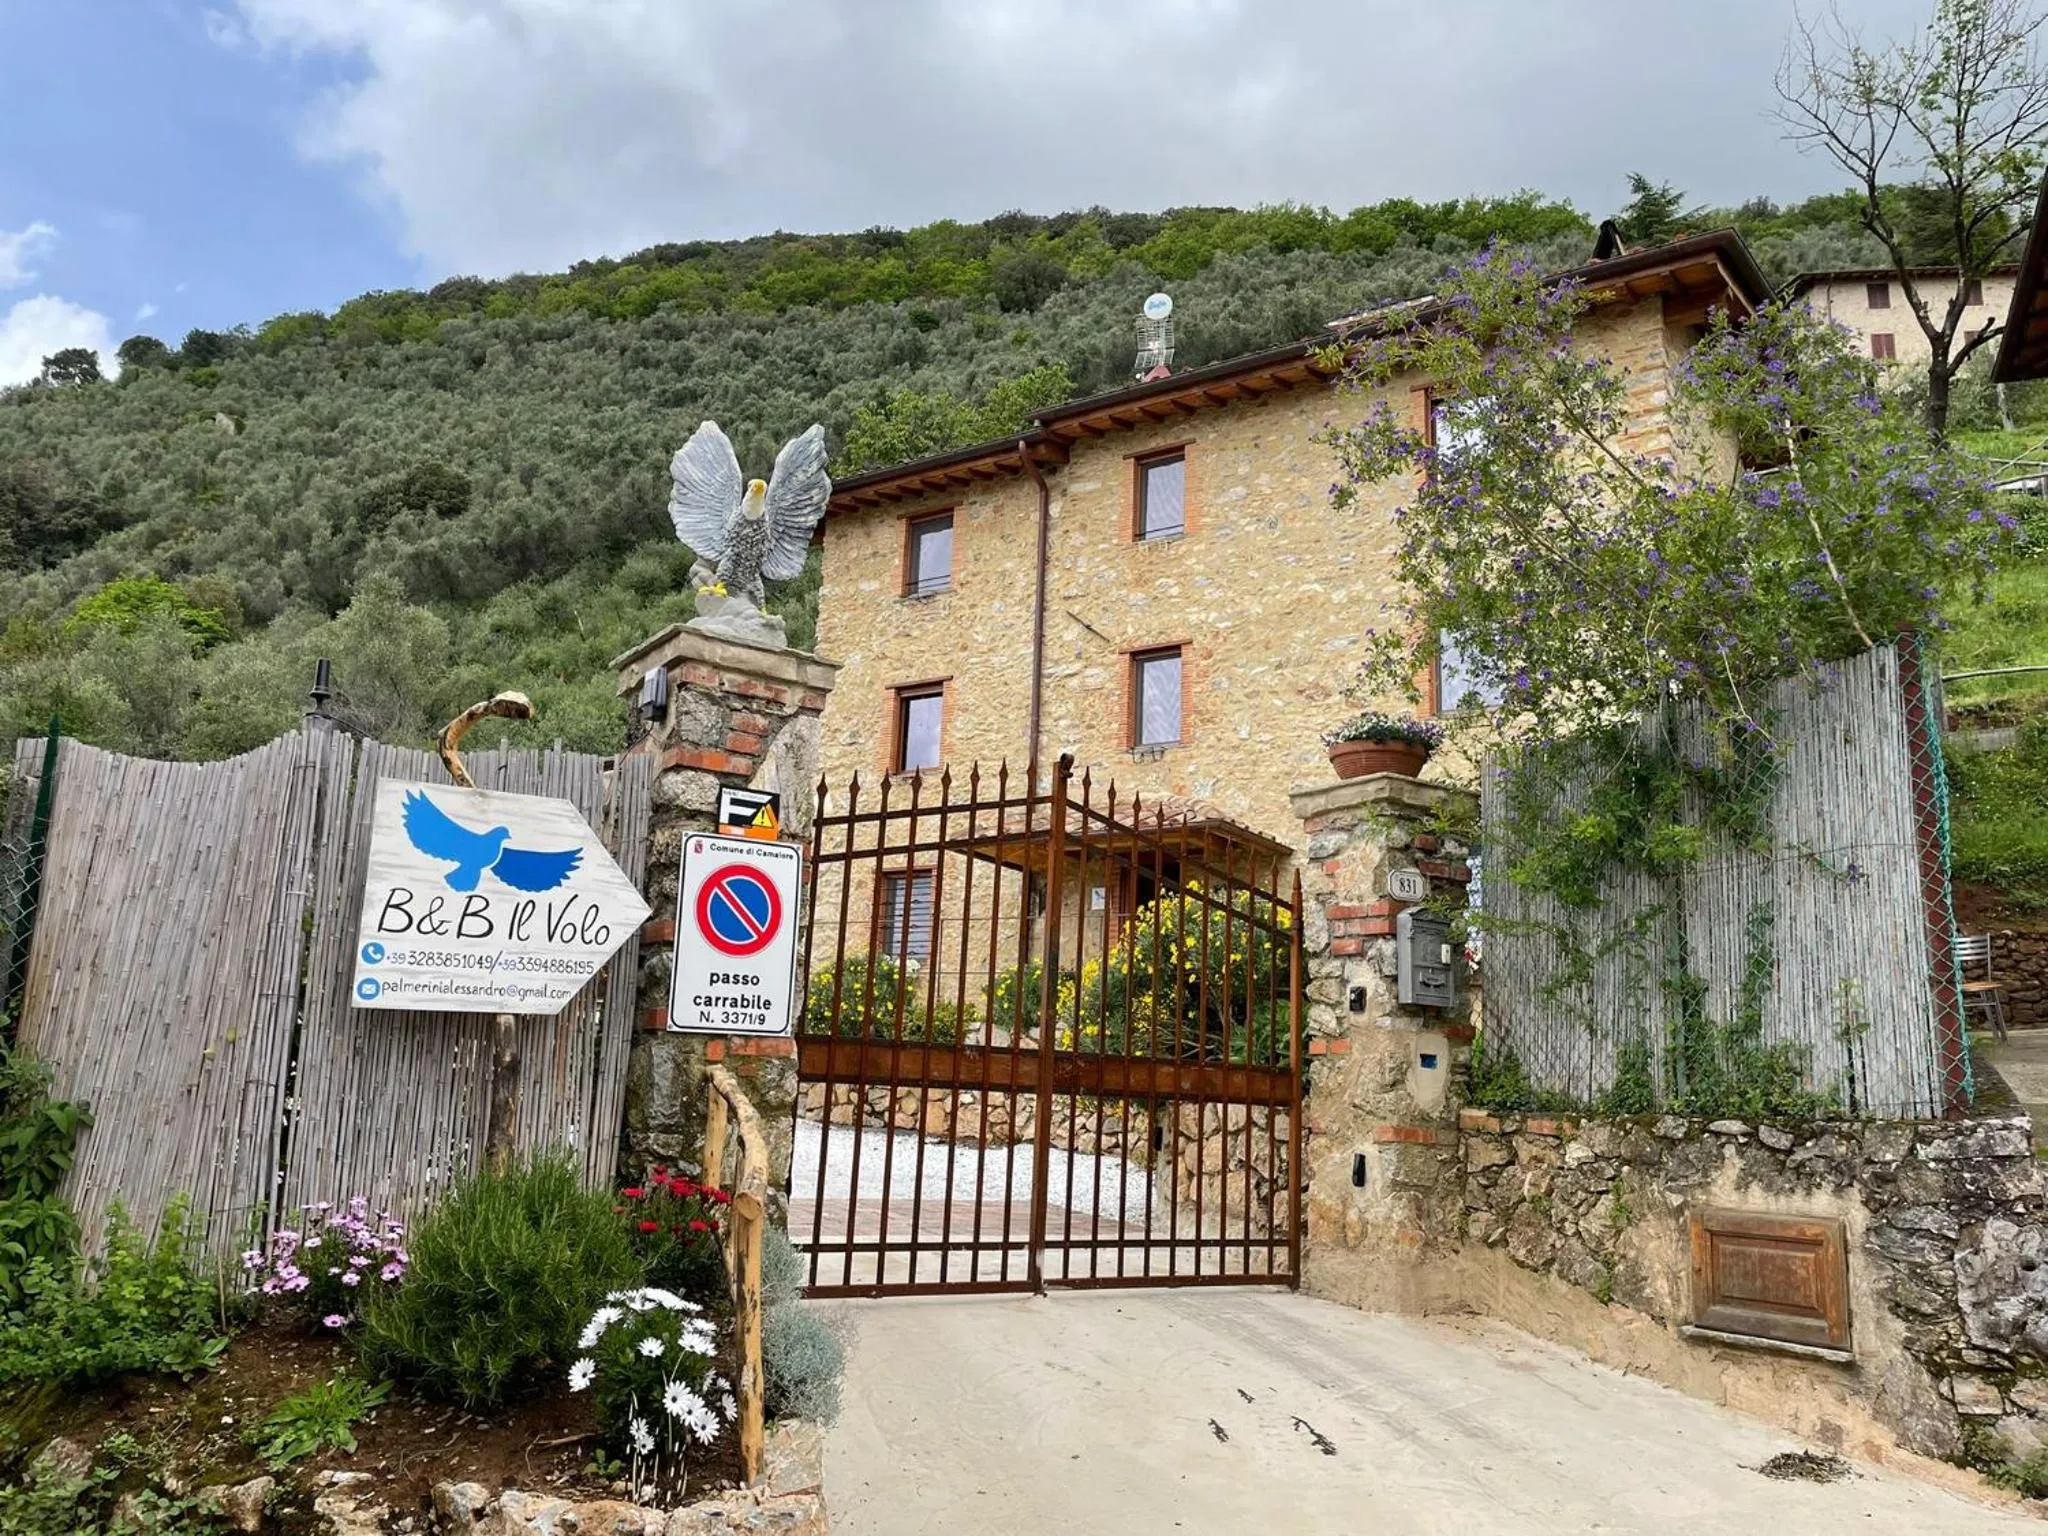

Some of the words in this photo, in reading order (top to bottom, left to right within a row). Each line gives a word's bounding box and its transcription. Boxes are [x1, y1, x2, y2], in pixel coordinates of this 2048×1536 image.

[710, 843, 744, 855] Comune
[746, 848, 754, 856] di
[756, 848, 794, 861] Camaiore
[1399, 877, 1417, 895] 831
[377, 887, 494, 939] B&B
[508, 899, 536, 942] Il
[548, 893, 610, 946] Volo
[709, 972, 760, 987] passo
[381, 978, 572, 1002] palmerinialessandro@gmail.com
[693, 993, 772, 1010] carrabile
[699, 1010, 715, 1024] N.
[721, 1011, 766, 1025] 3371/9
